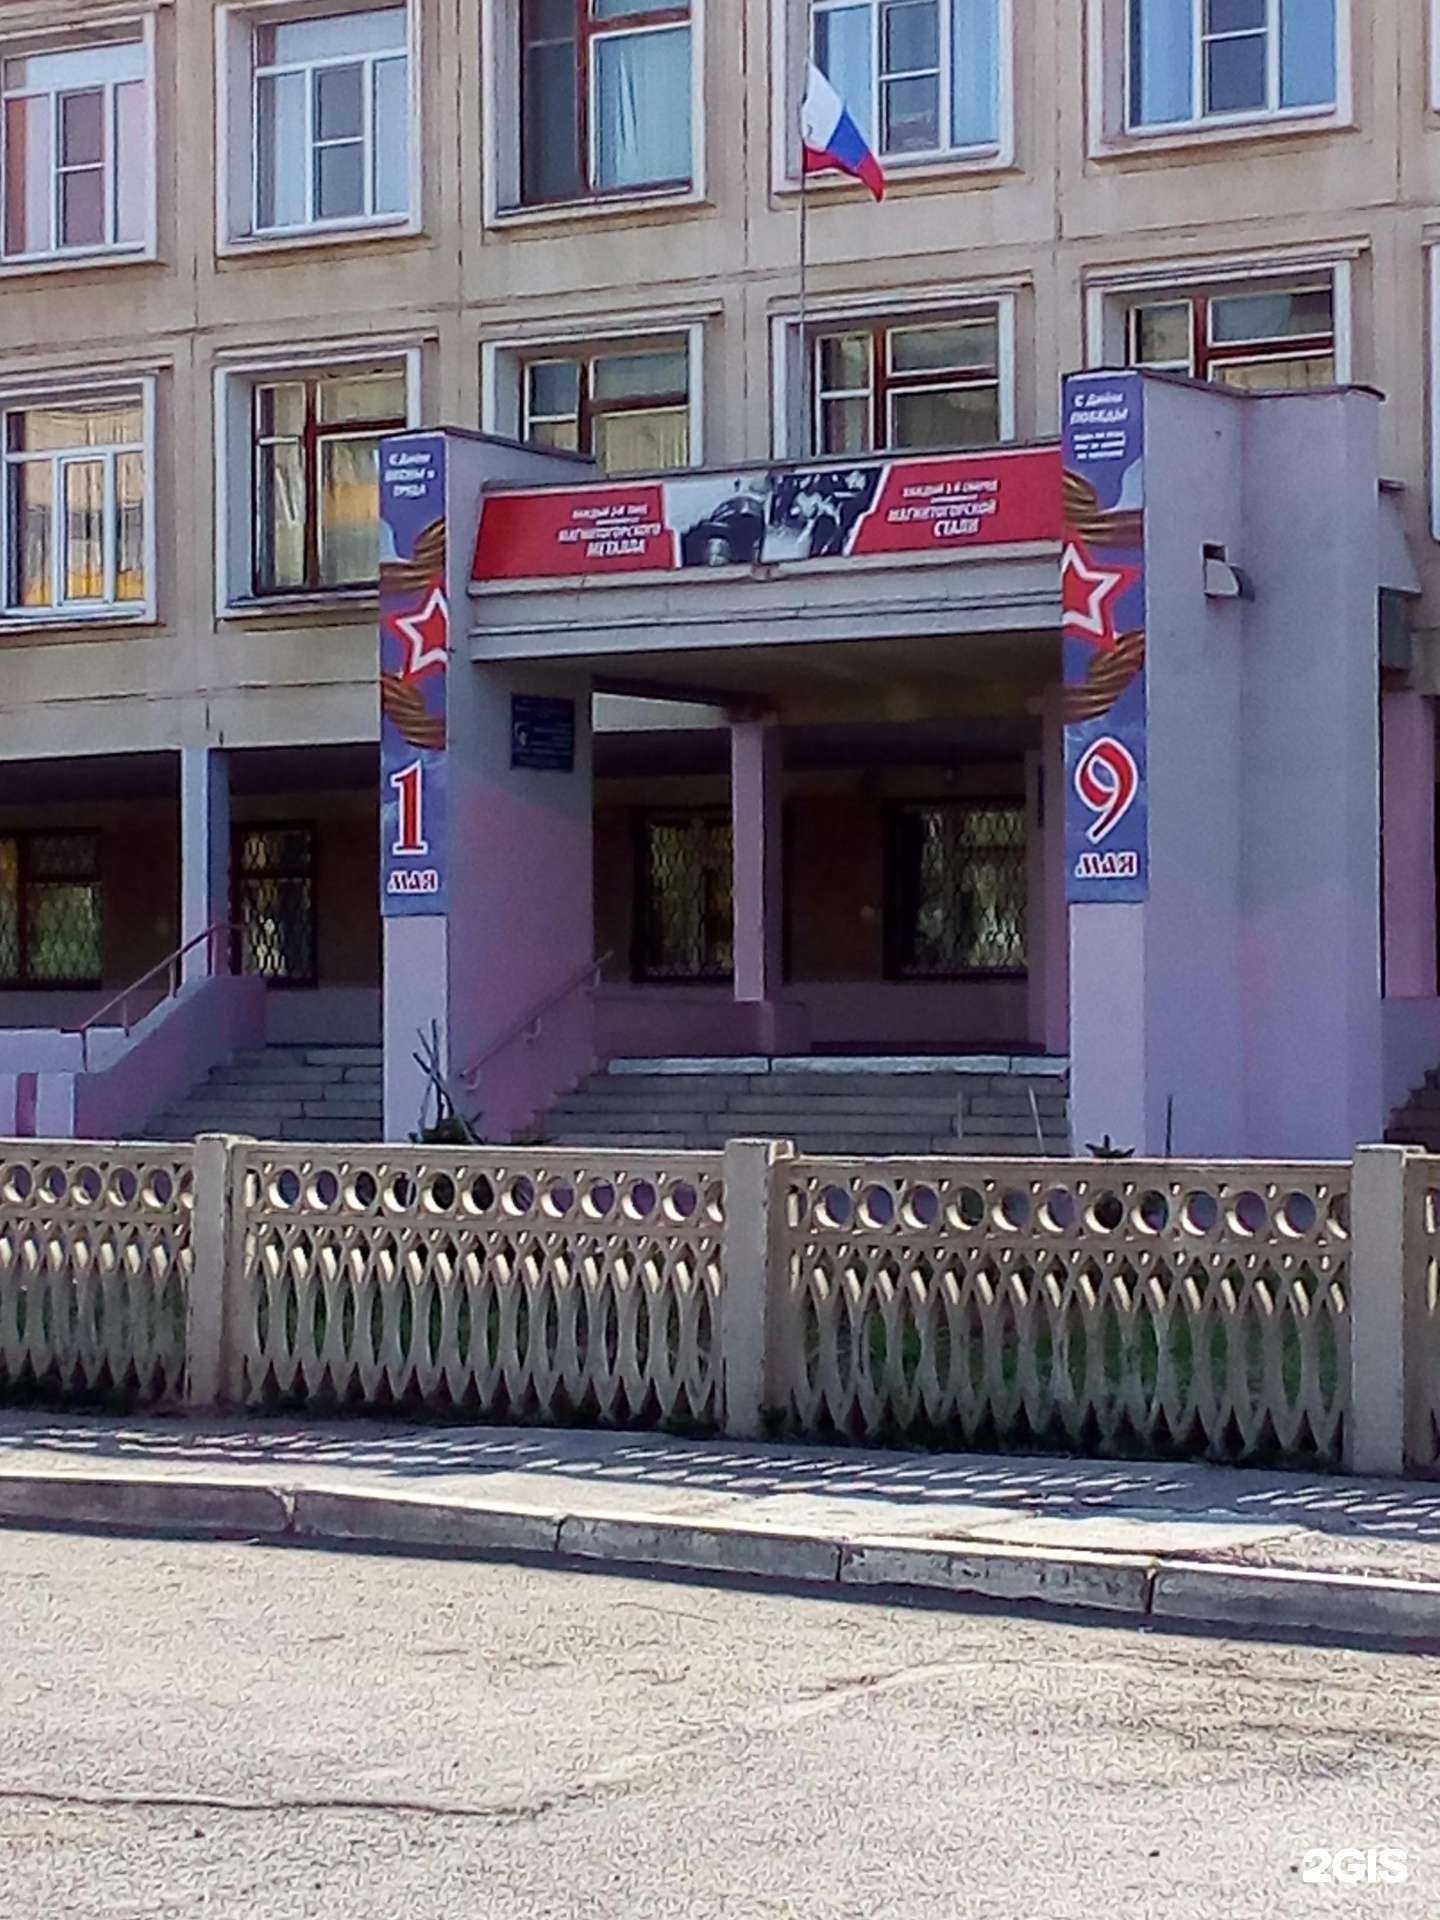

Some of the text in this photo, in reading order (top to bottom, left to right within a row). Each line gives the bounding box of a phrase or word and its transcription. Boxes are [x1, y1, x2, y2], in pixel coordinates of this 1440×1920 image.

[934, 518, 979, 537] СТАЛИ
[390, 760, 428, 856] 1
[1074, 736, 1138, 844] 9
